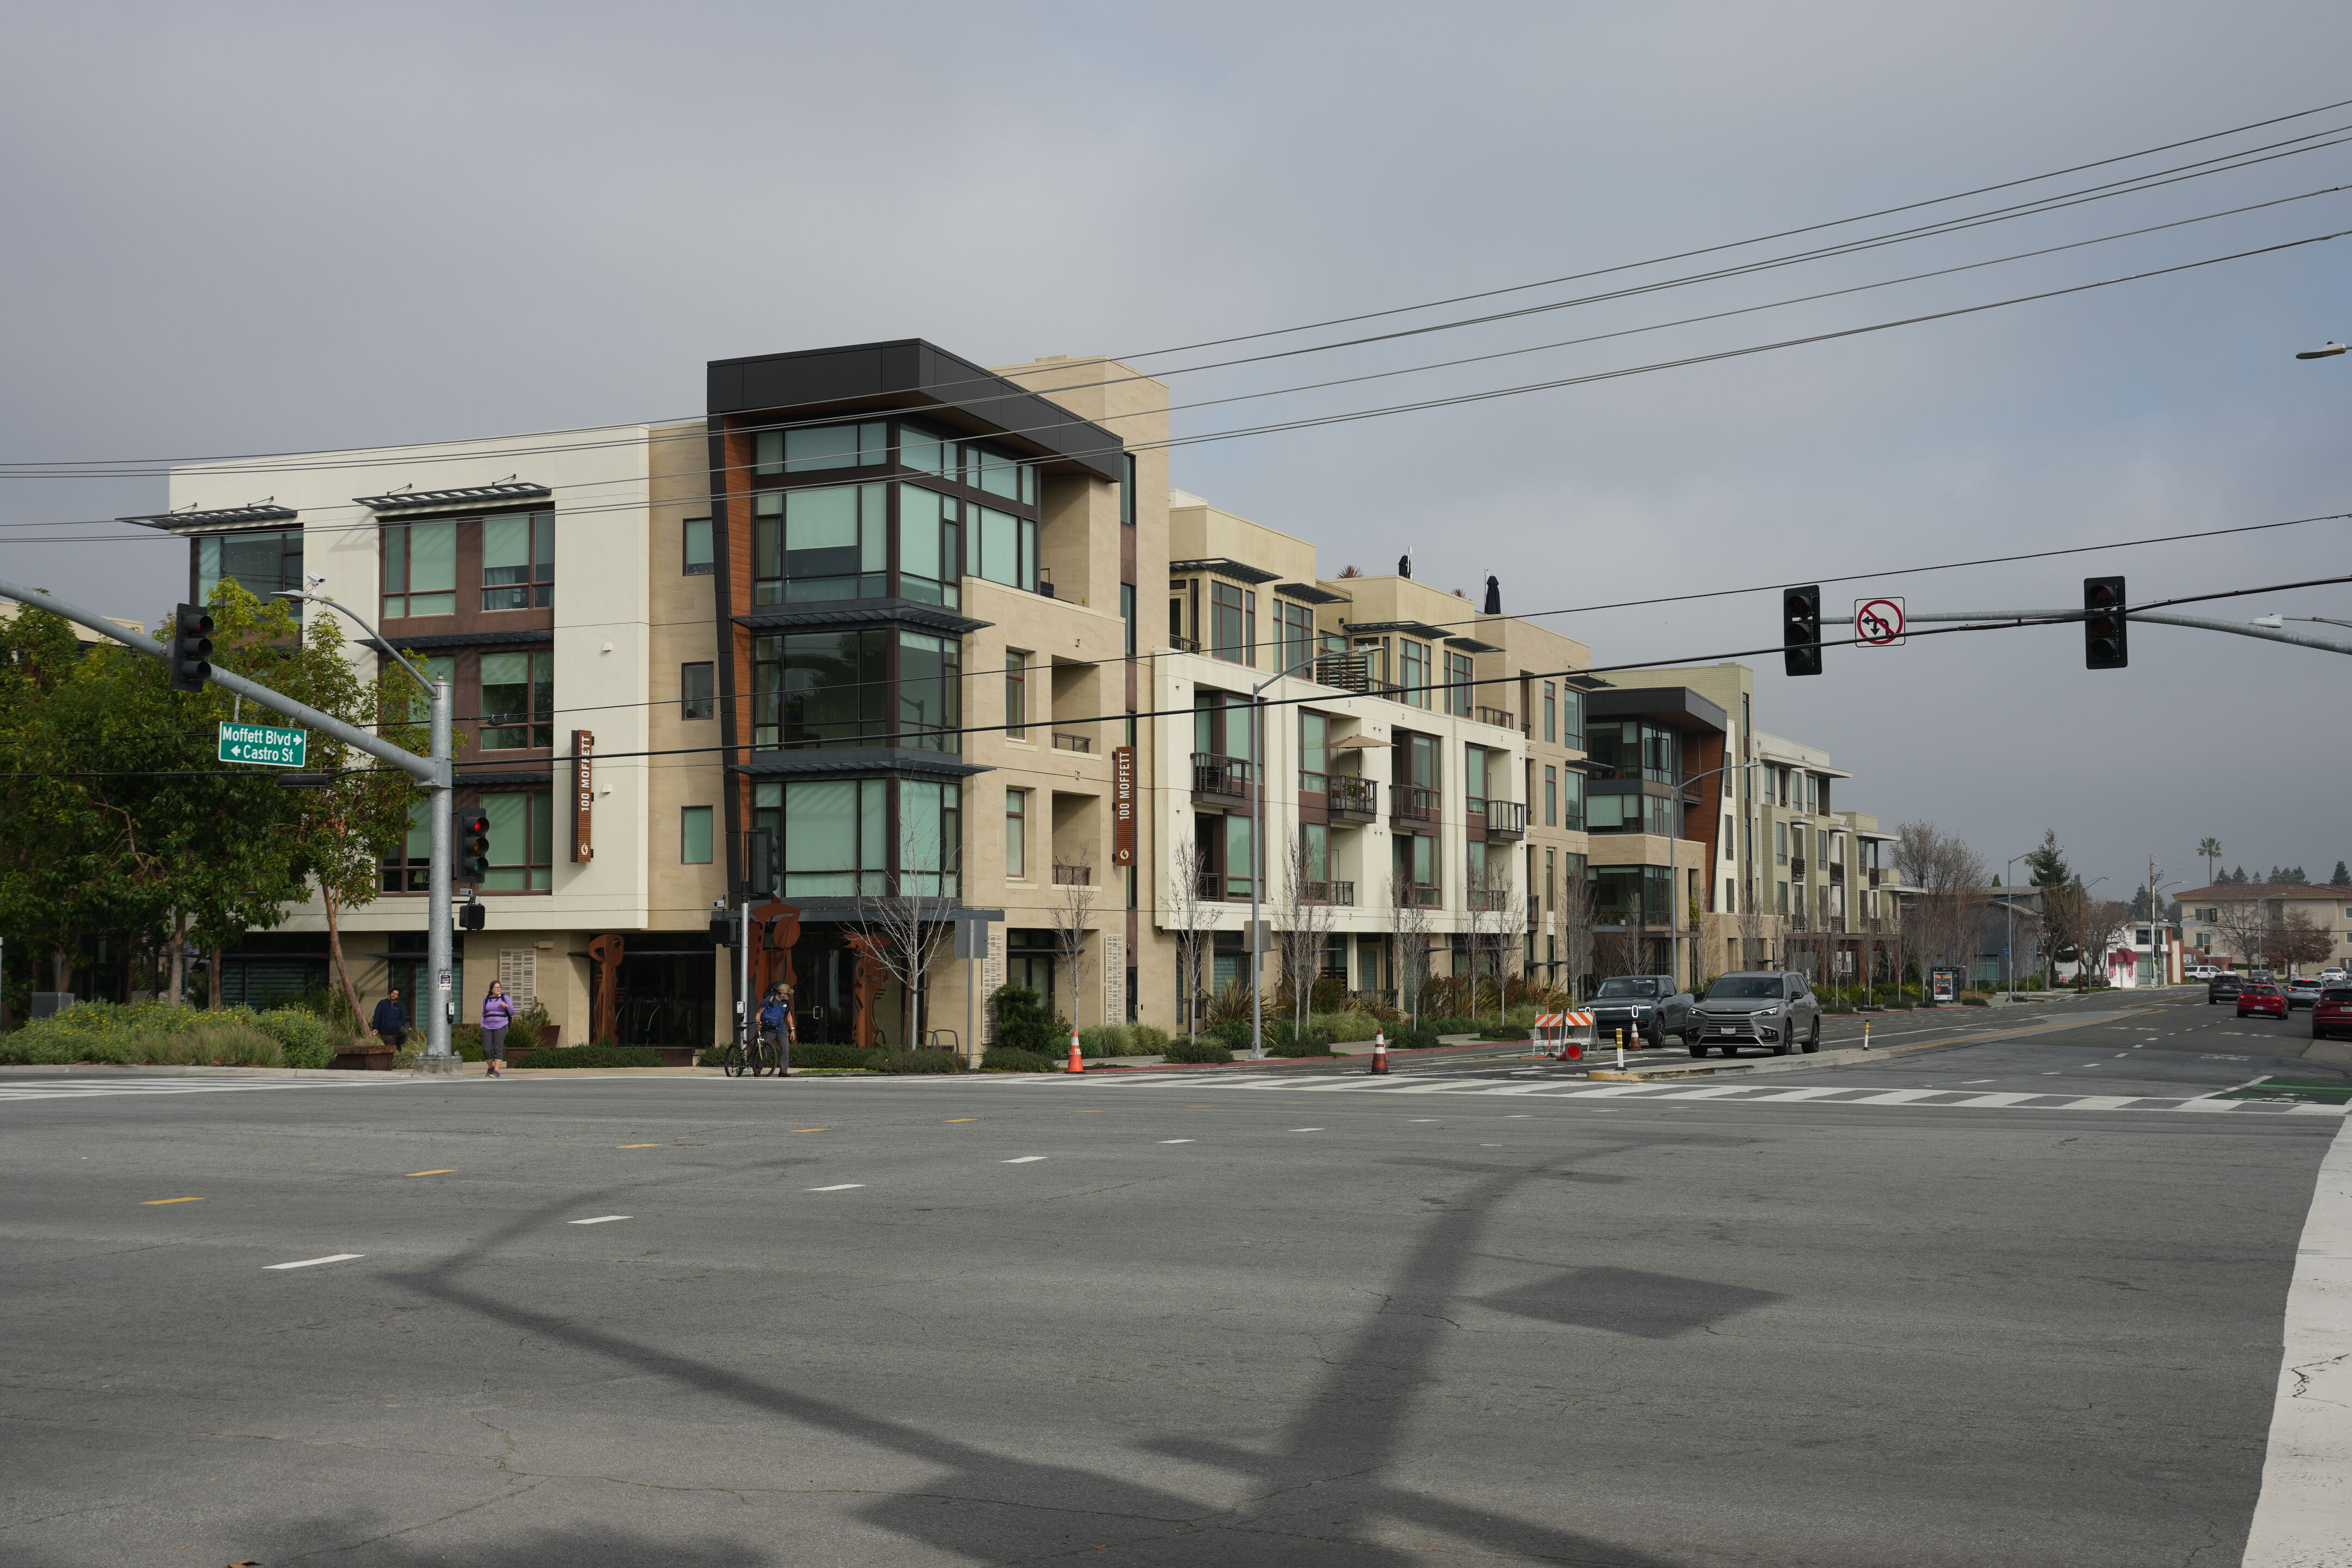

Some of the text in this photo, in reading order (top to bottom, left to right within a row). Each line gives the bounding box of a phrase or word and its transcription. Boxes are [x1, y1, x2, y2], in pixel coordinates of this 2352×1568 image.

[222, 726, 291, 746] Moffett Blvd
[243, 744, 294, 762] Castro St
[581, 736, 590, 812] 100 MOFFETT
[1119, 752, 1130, 820] 100 MOFFETT
